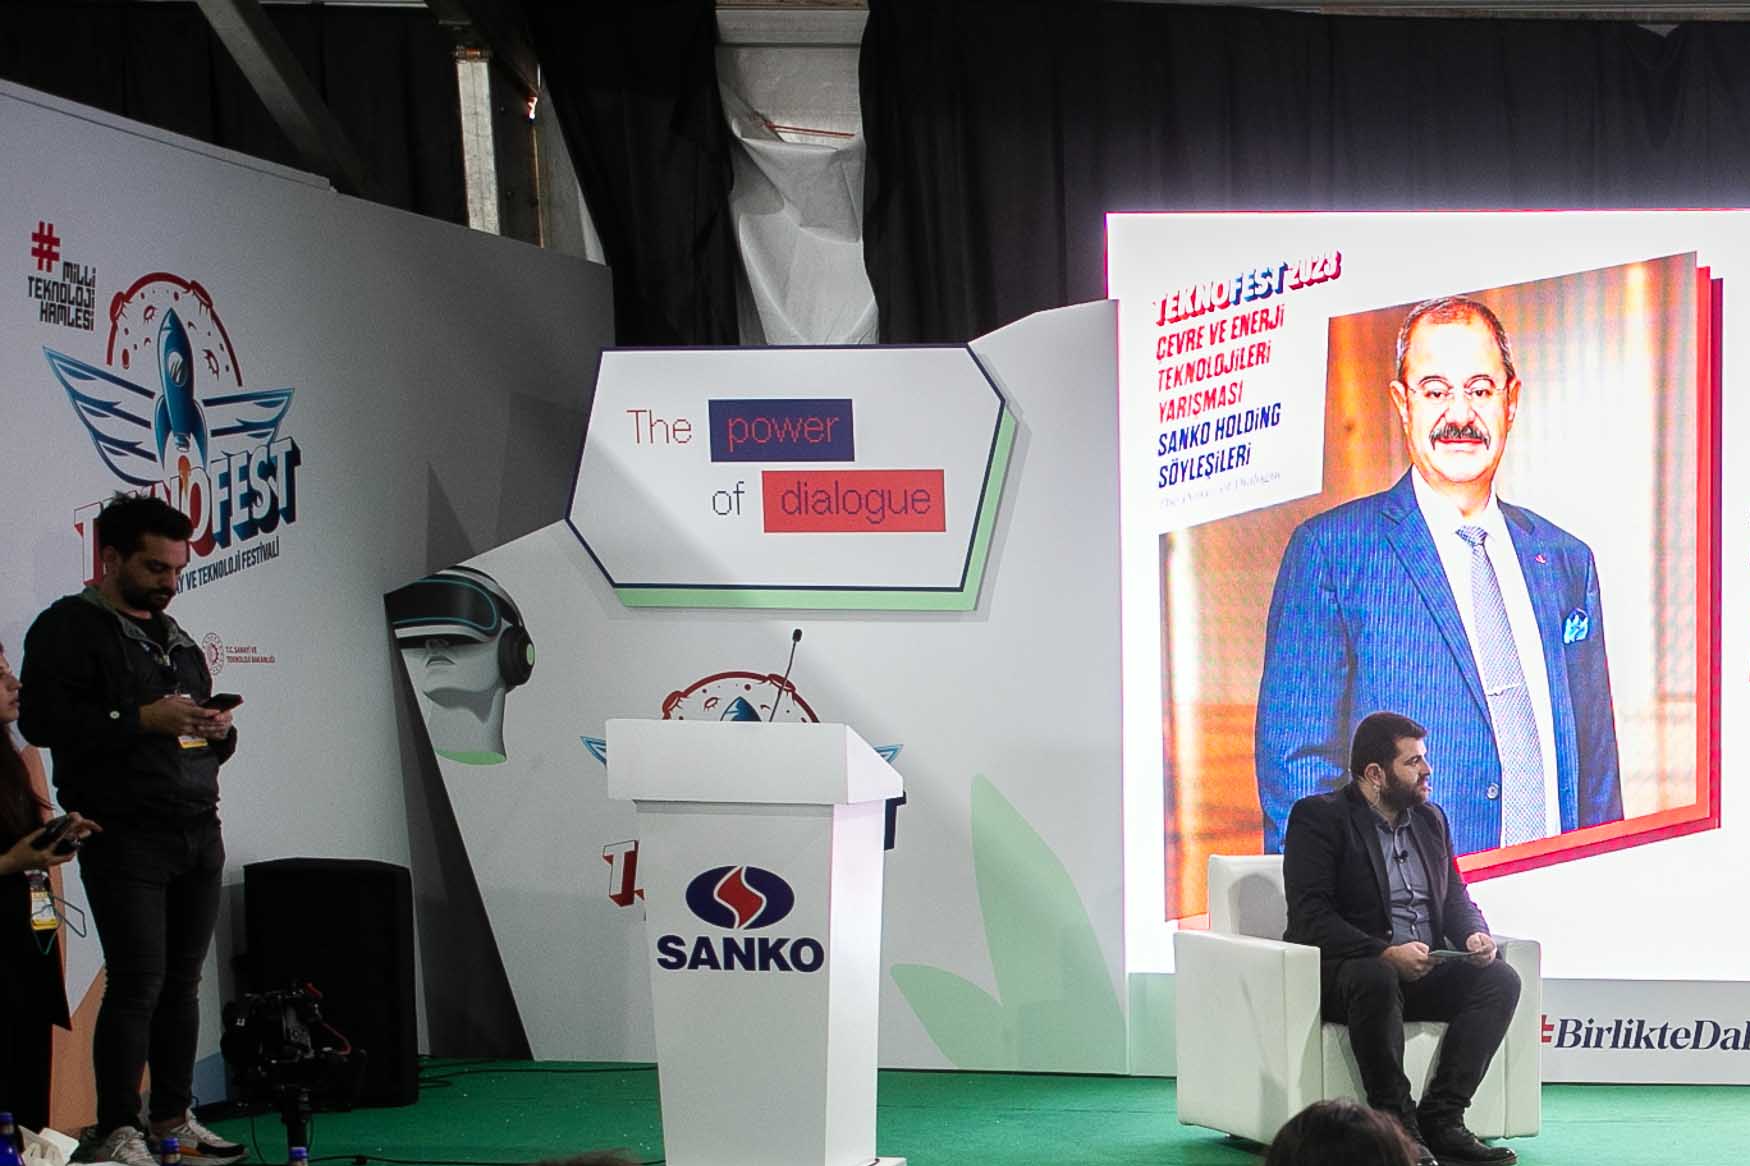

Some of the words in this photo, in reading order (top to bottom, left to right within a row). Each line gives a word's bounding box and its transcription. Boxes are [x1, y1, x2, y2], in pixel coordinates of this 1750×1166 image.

[1210, 319, 1227, 346] VE
[626, 409, 692, 445] The
[726, 414, 840, 452] power
[1158, 421, 1210, 456] SANKO
[712, 481, 745, 515] of
[780, 481, 931, 524] dialogue
[656, 934, 825, 974] SANKO
